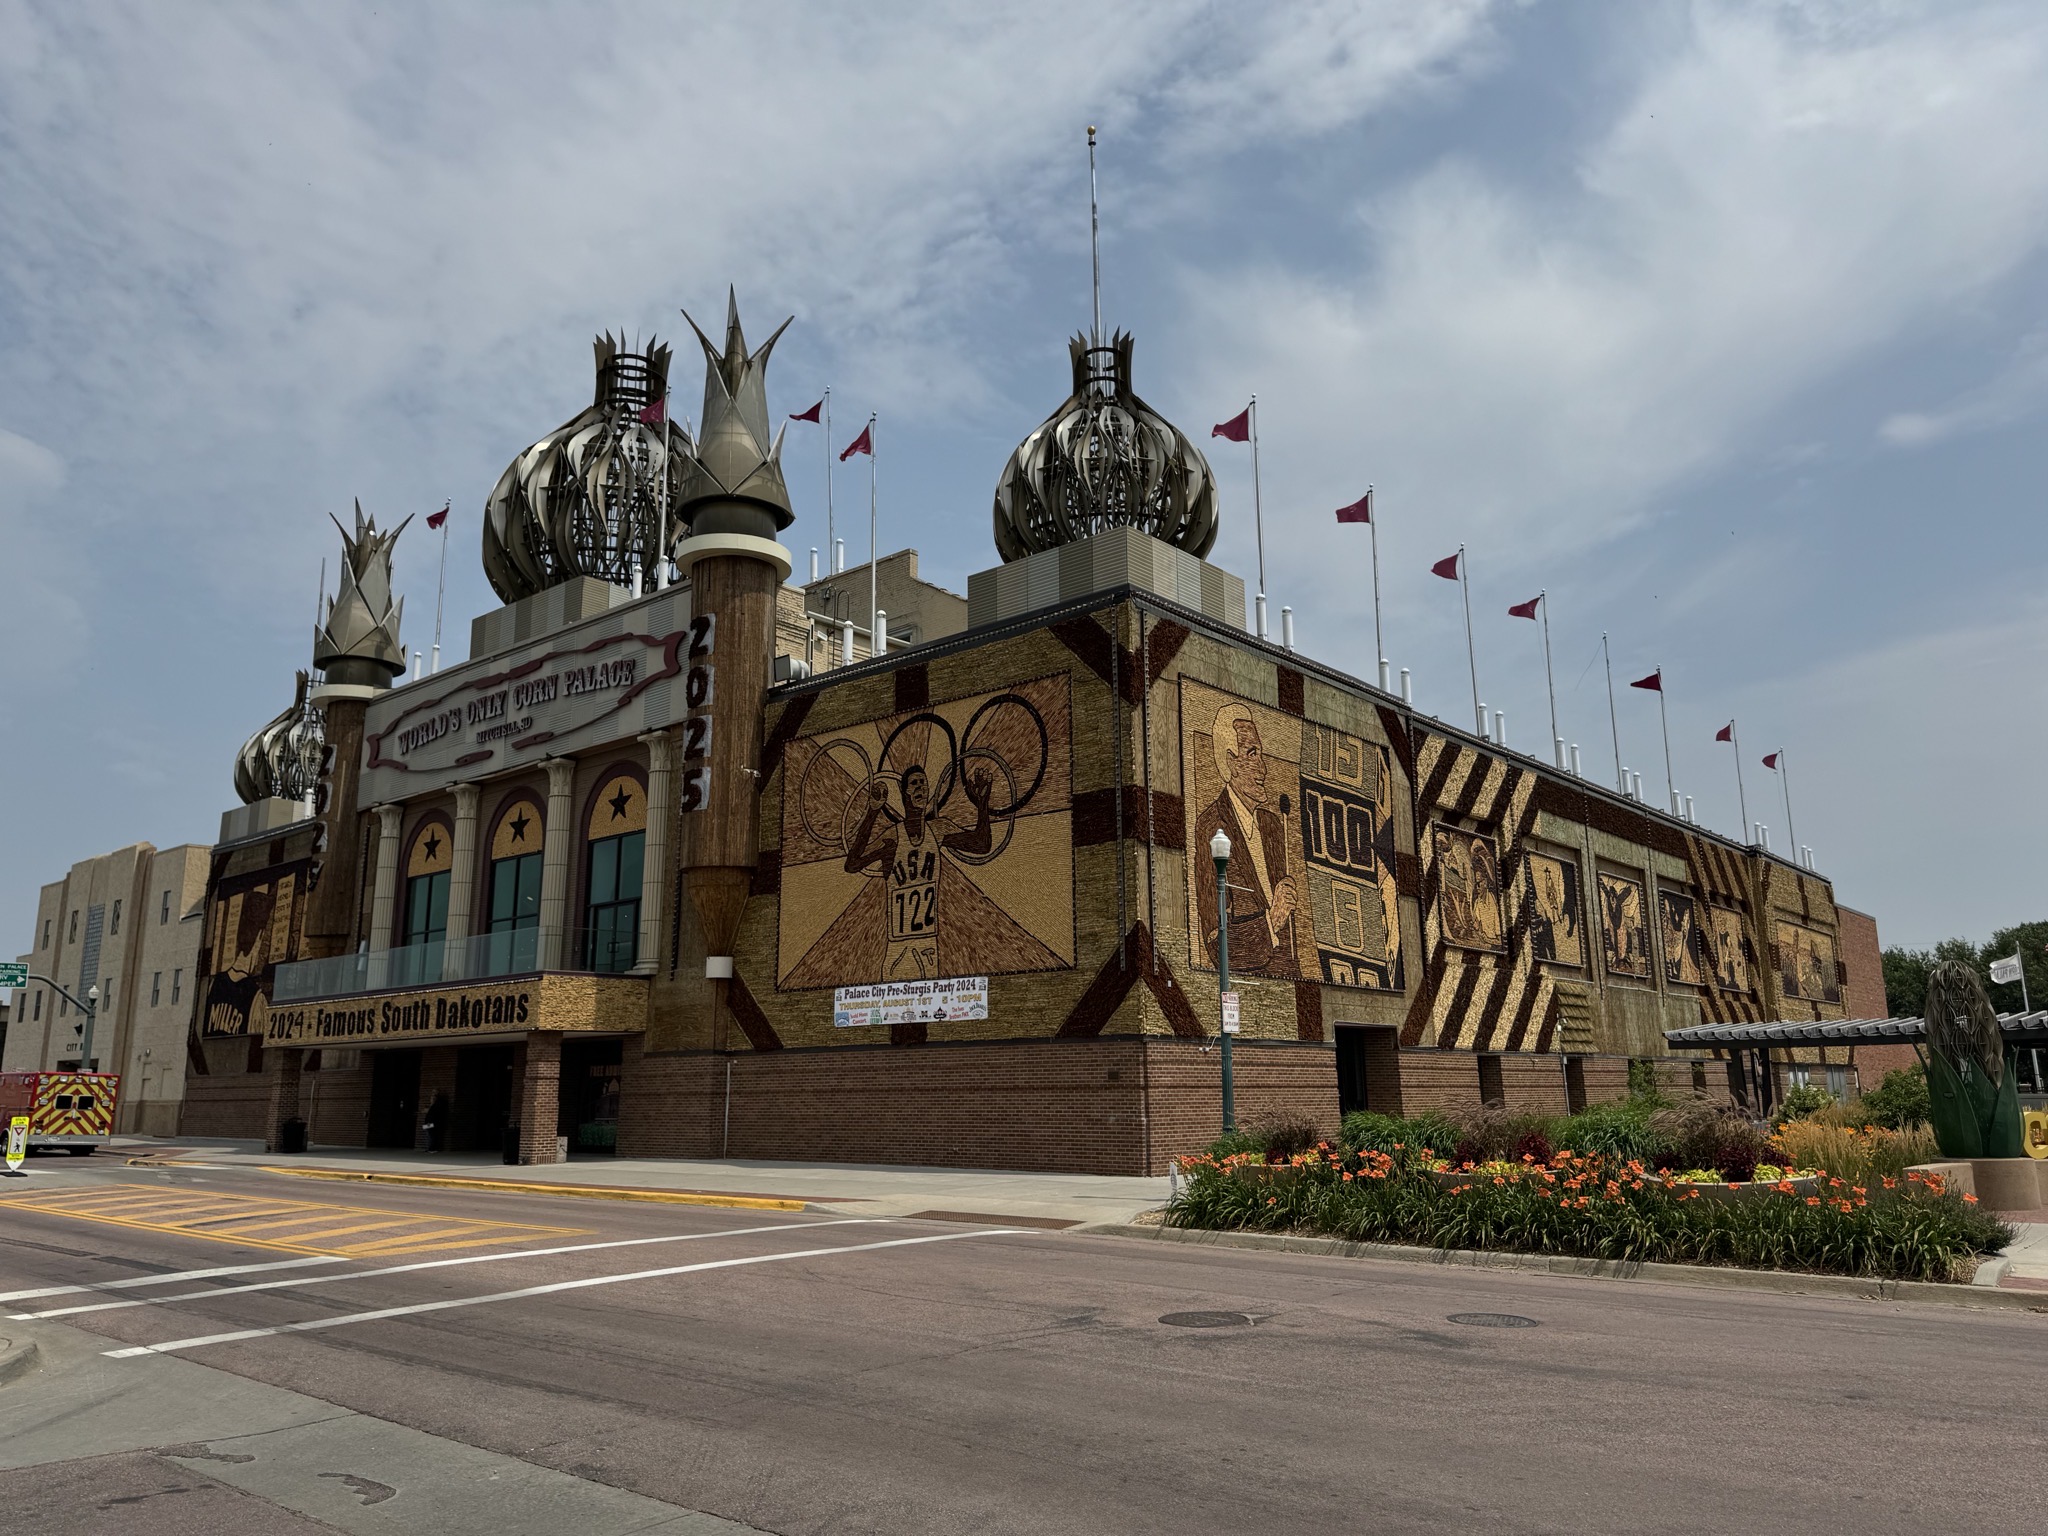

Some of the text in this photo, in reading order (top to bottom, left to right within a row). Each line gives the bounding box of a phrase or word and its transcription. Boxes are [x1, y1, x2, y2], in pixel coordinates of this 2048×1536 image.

[398, 658, 635, 755] WORLD'S ONLY CORN PALACE
[681, 615, 713, 813] 2025
[1305, 788, 1376, 872] 100
[892, 849, 936, 887] USA
[844, 988, 870, 1000] Palace
[872, 986, 886, 999] City
[932, 981, 955, 995] Party
[956, 979, 976, 993] 2024
[883, 998, 915, 1007] AUGUST
[917, 996, 933, 1005] 1ST
[958, 993, 983, 1003] 10PM
[207, 1002, 243, 1035] MILLER
[269, 1011, 305, 1039] 2024
[316, 1007, 376, 1037] Famous
[381, 999, 431, 1034] South
[436, 993, 529, 1028] Dakotans
[66, 1043, 78, 1051] CITY
